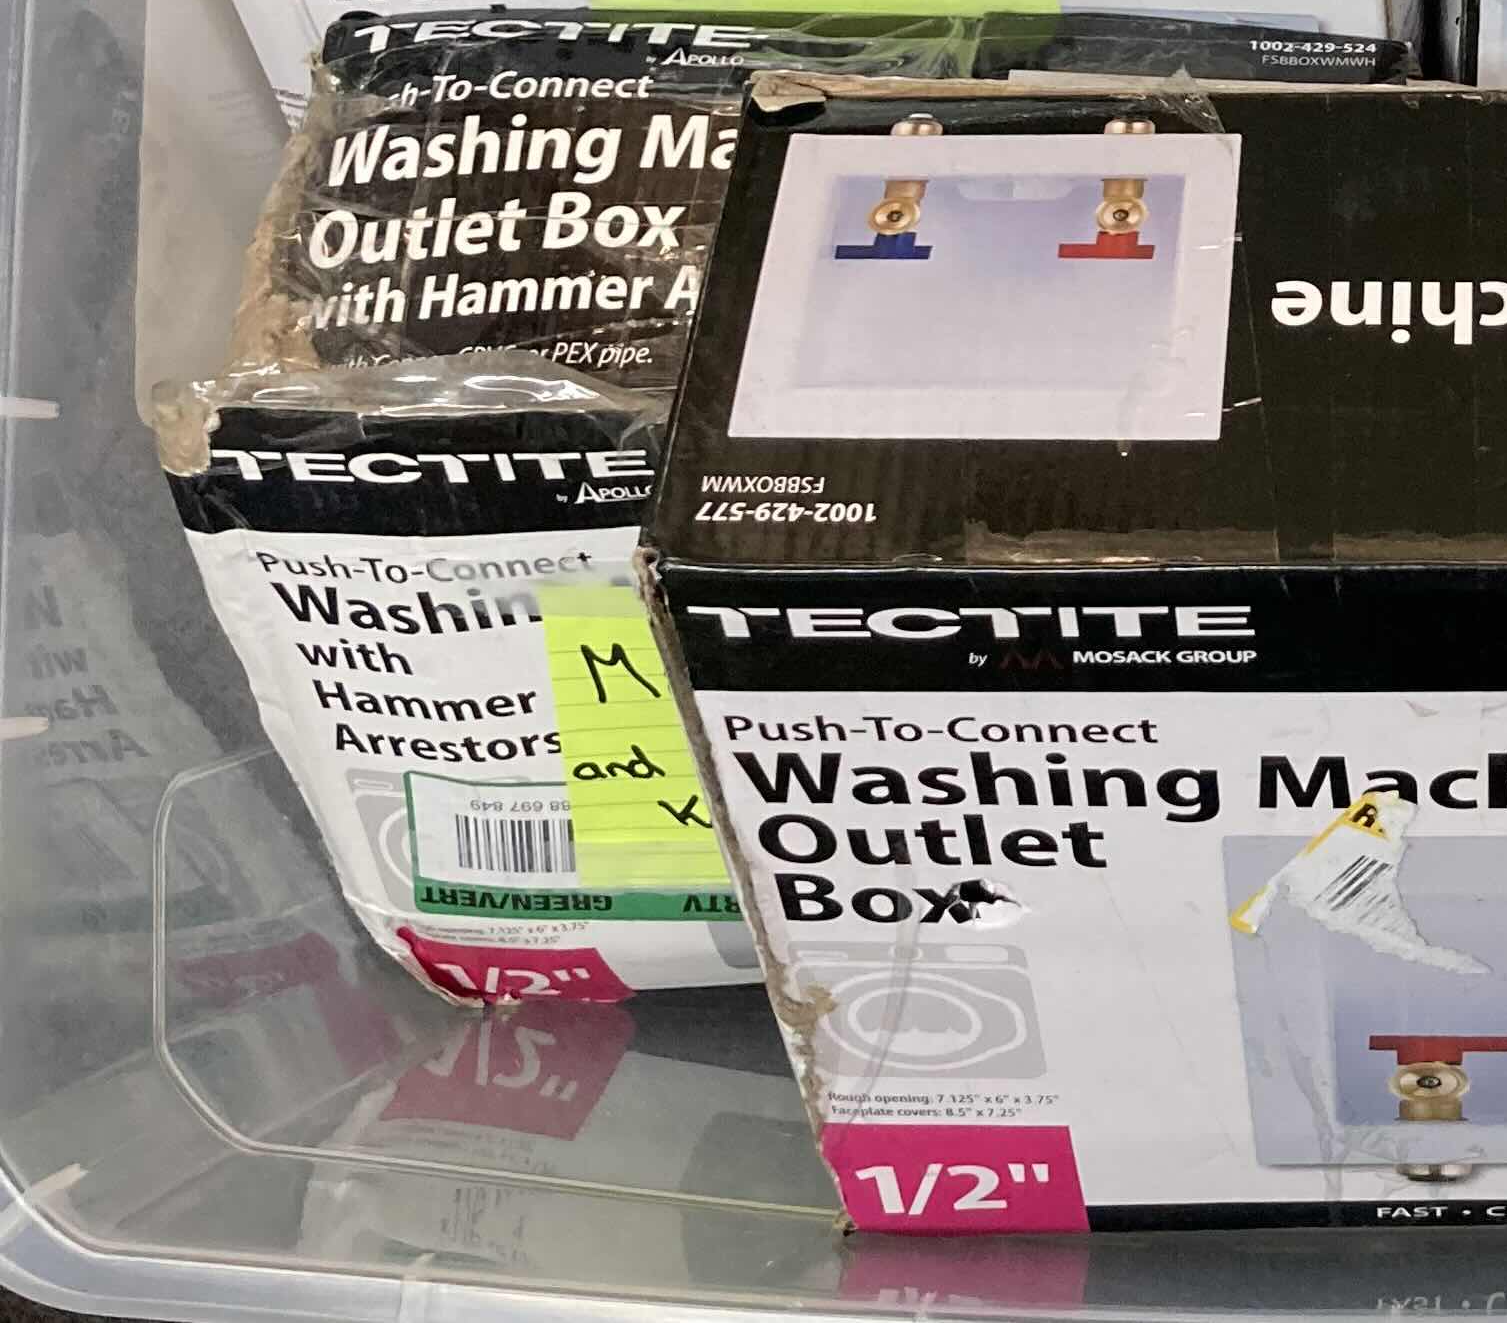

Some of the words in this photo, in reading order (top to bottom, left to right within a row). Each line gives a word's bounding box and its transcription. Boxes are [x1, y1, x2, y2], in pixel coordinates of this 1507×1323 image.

[354, 20, 770, 54] TECTITE
[1250, 40, 1377, 54] 1002-429-524
[662, 48, 744, 67] APOLLO
[1261, 54, 1376, 67] FSBBOXWMWH
[328, 114, 622, 185] Washing
[309, 197, 527, 269] Outlet
[543, 191, 687, 249] Box
[418, 271, 654, 321] Hammer
[552, 342, 593, 363] PEX
[597, 344, 653, 368] pipe.
[210, 449, 655, 483] TECTITE
[701, 475, 825, 494] FSBBOXWM
[696, 500, 877, 523] 1002-429-577
[255, 550, 593, 584] Push-To-Connect
[686, 606, 1256, 638] TECTITE
[296, 640, 414, 677] with
[581, 643, 661, 704] M
[1073, 650, 1172, 665] MOSACK
[1176, 649, 1257, 665] GROUP
[313, 679, 537, 723] Hammer
[335, 723, 562, 765] Arrestors
[723, 715, 1158, 744] Push-To-Connect
[572, 745, 666, 781] and
[733, 752, 1220, 822] Washing
[470, 799, 503, 812] 849
[509, 799, 543, 812] 697
[757, 813, 1107, 868] Outlet
[421, 885, 613, 912] GREEN/VERT
[774, 873, 984, 924] Box
[855, 1163, 1050, 1215] 1/2"
[1377, 1207, 1443, 1219] FAST
